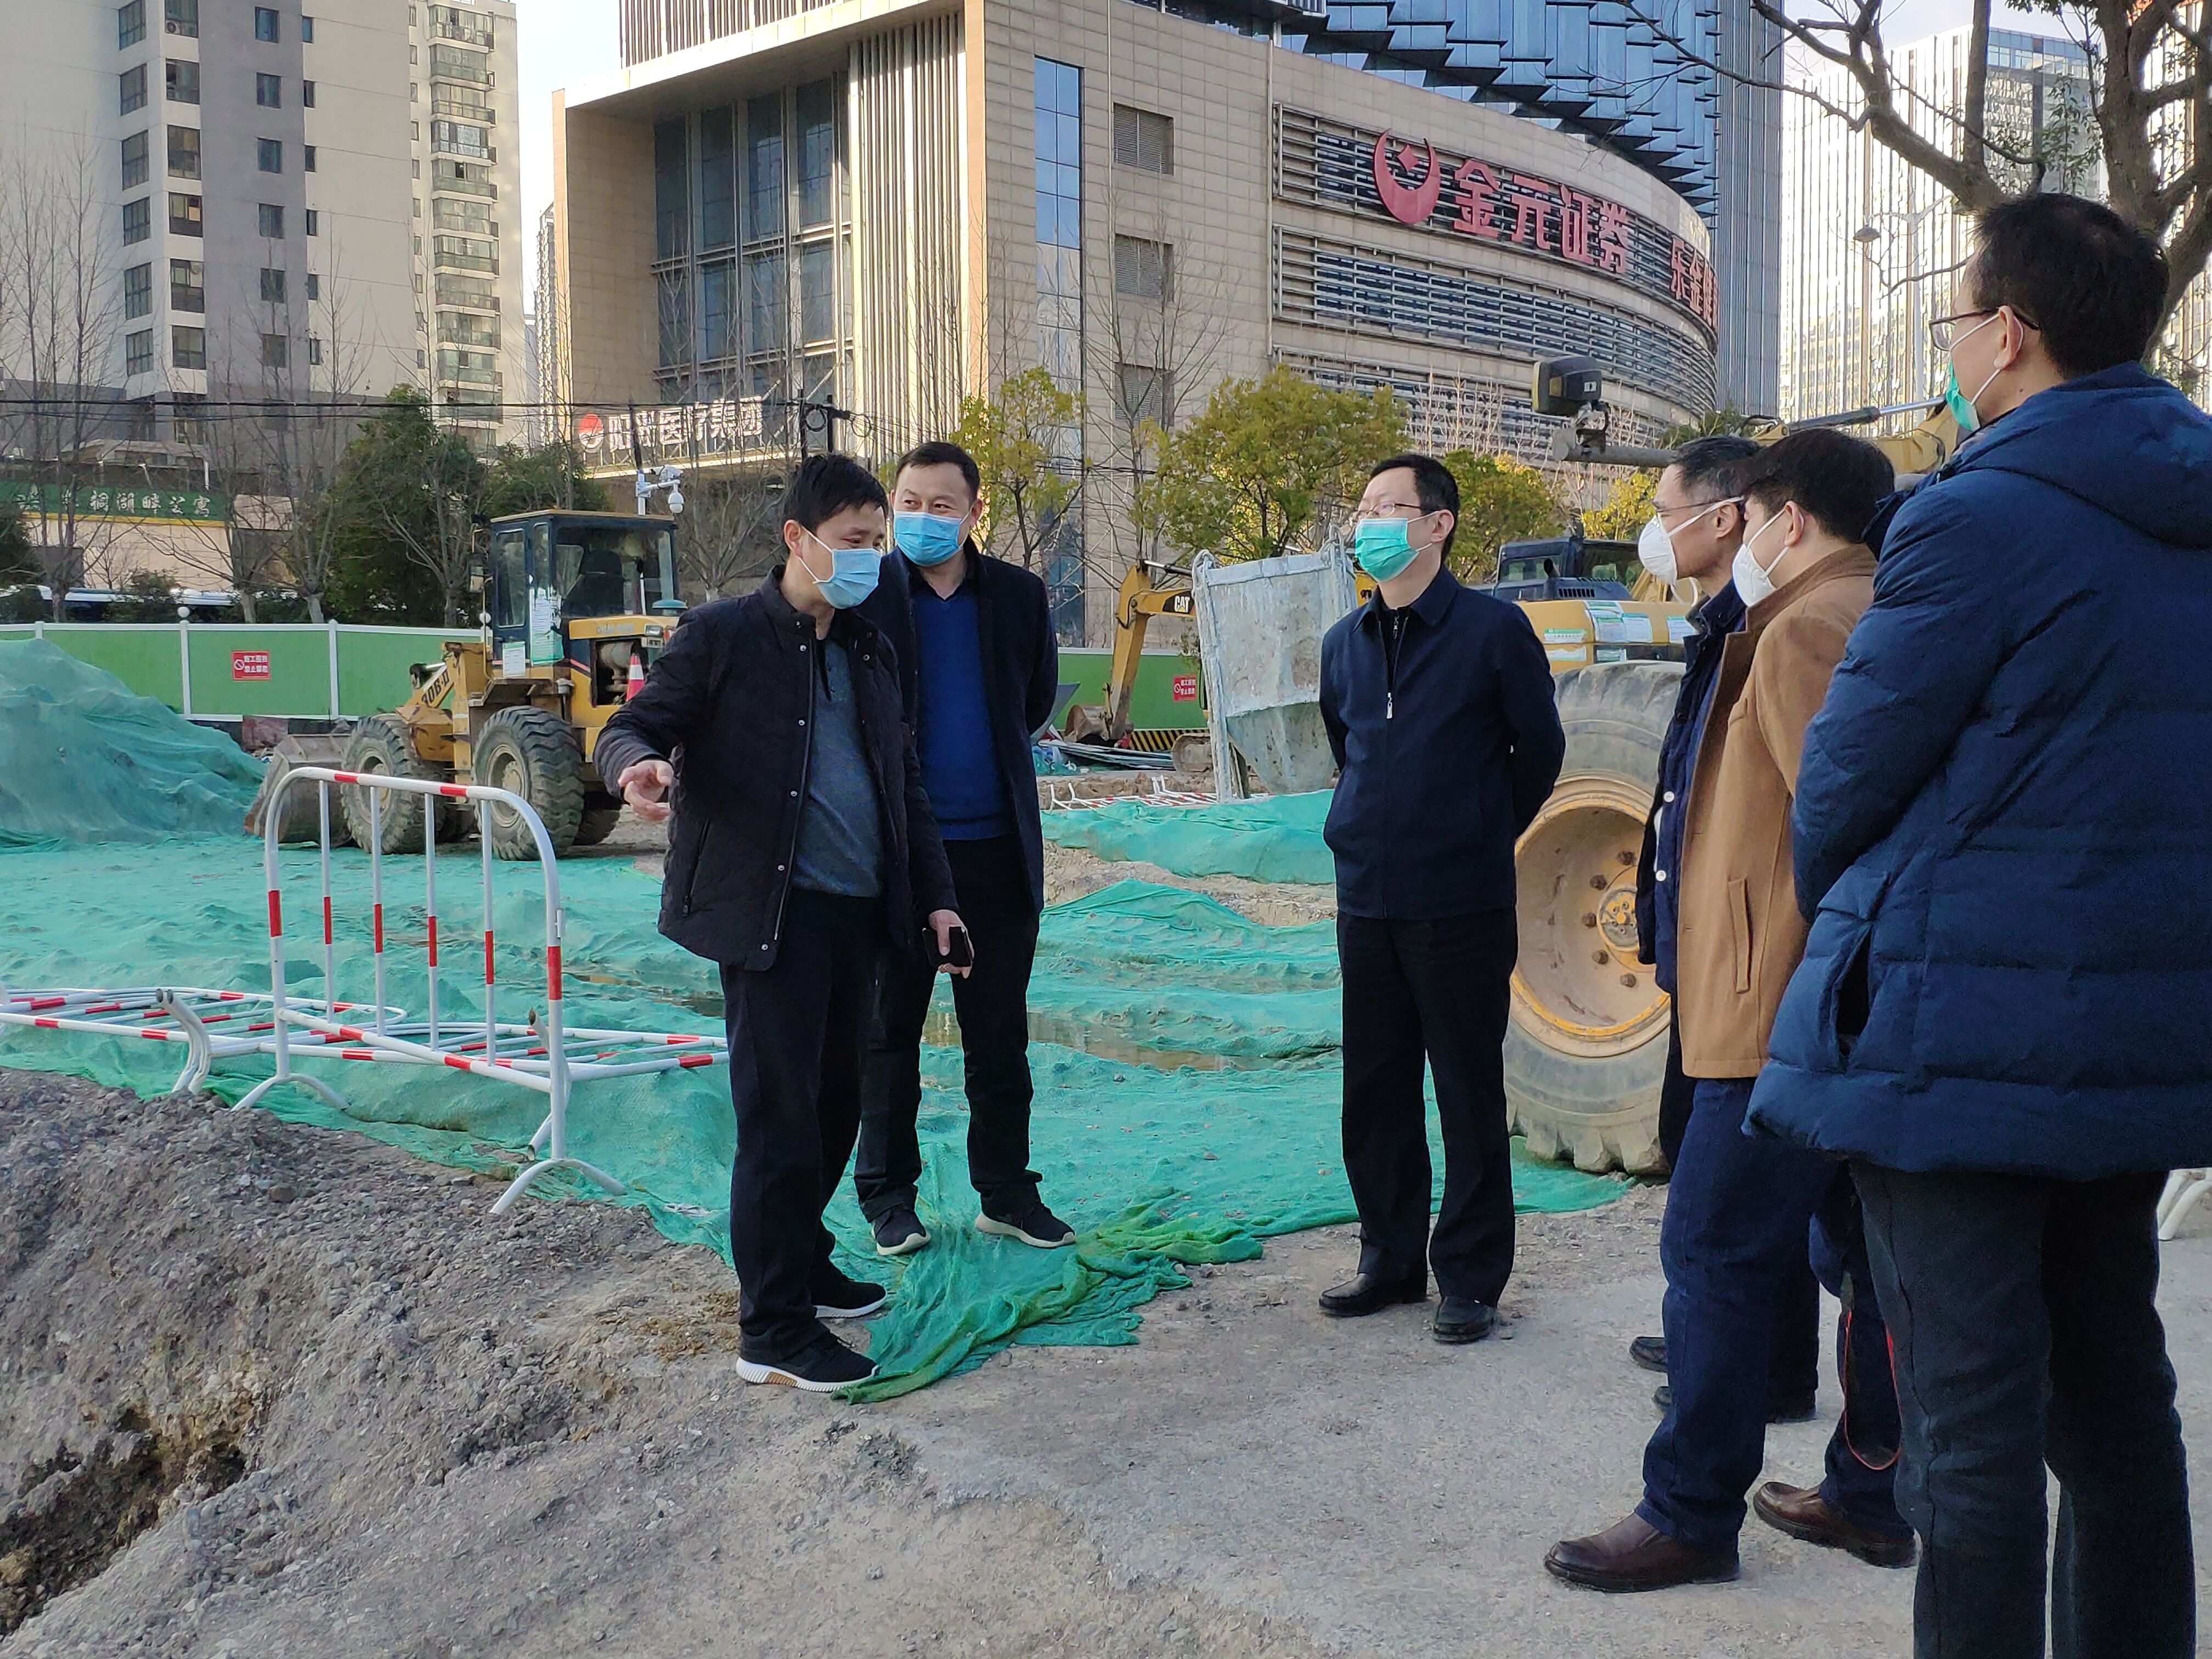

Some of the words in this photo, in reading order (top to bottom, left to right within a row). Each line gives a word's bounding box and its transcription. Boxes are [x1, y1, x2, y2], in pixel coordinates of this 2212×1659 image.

[1453, 159, 1629, 274] 金元证券
[1175, 595, 1190, 612] CAT
